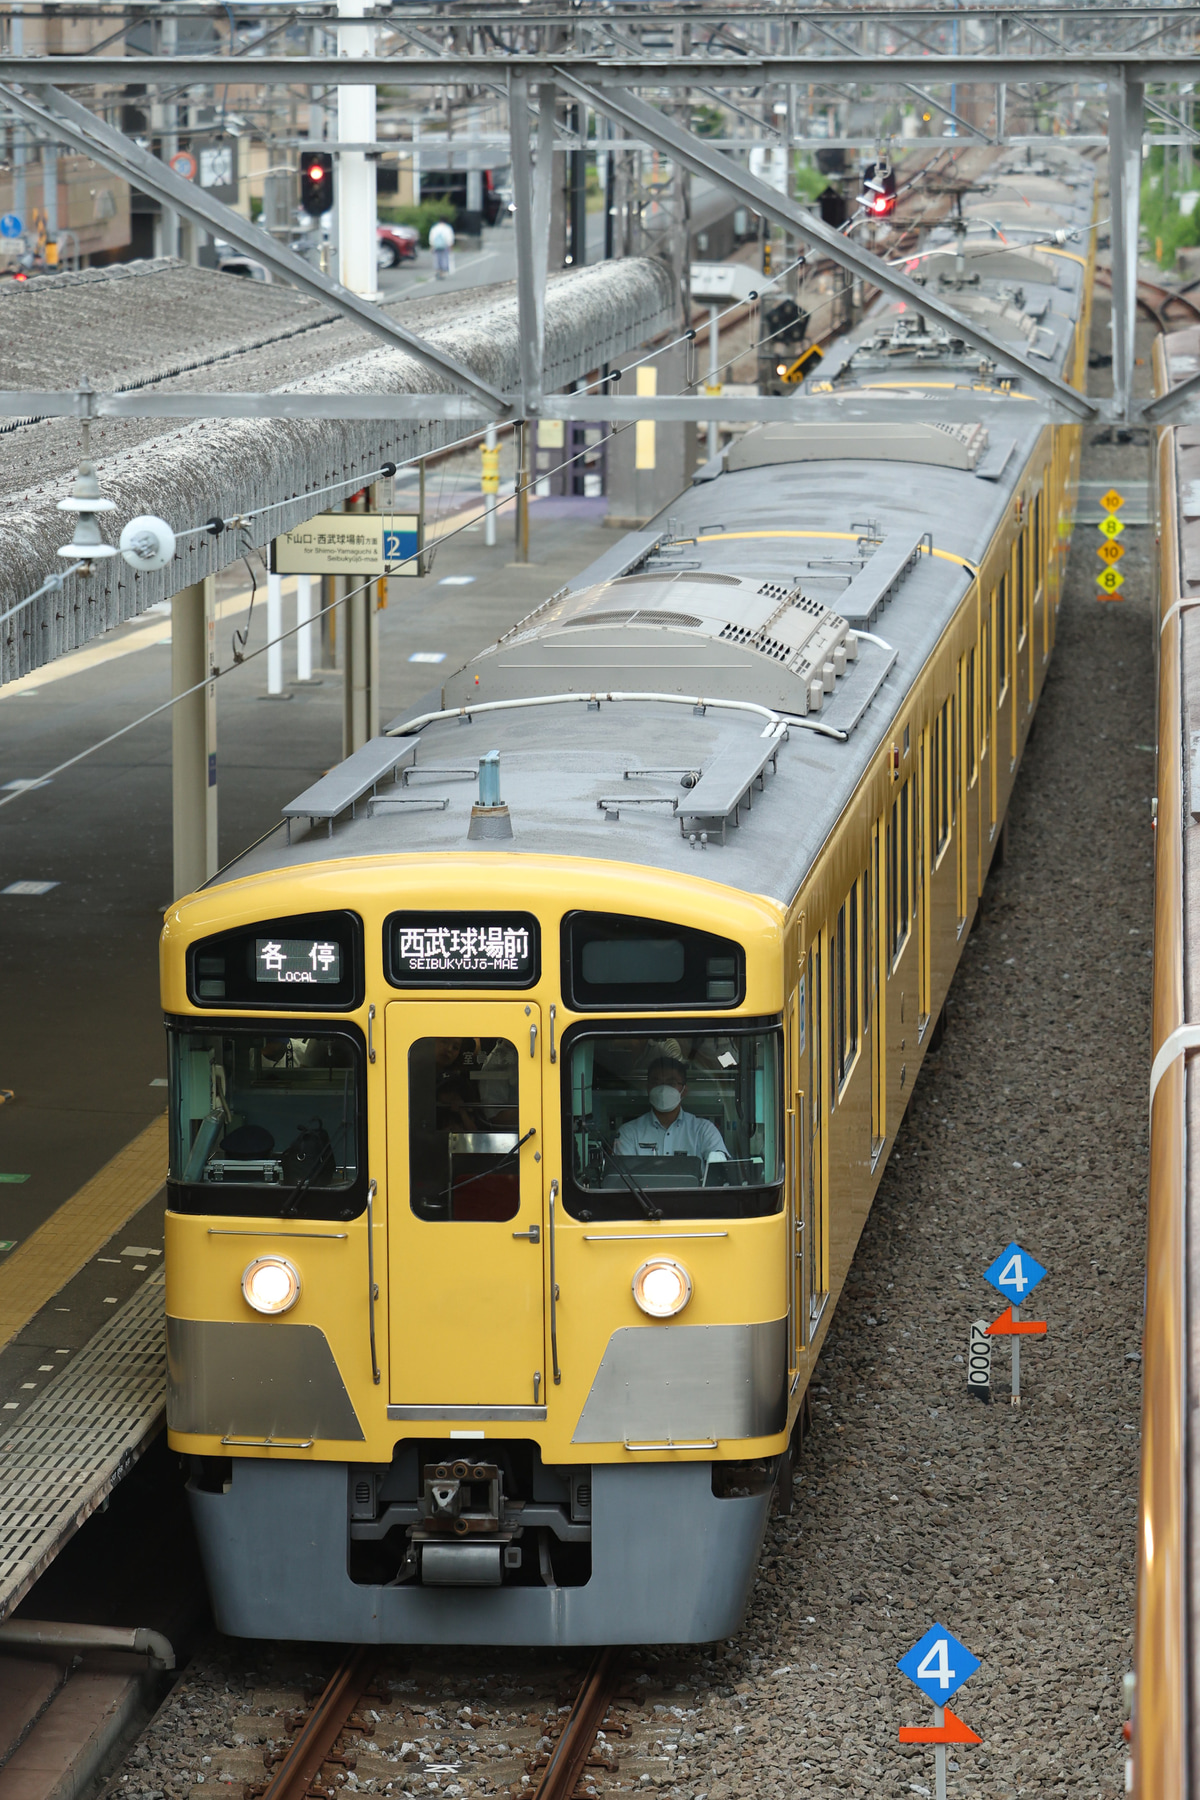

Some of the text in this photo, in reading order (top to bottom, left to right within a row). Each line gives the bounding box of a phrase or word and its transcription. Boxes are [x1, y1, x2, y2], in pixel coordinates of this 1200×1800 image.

[1106, 496, 1120, 508] 10
[1106, 520, 1117, 534] 8
[386, 536, 401, 557] 2
[1104, 546, 1119, 559] 10
[1105, 573, 1116, 588] 8
[399, 926, 529, 959] 西武球場前
[277, 971, 318, 983] LOCAL
[998, 1254, 1029, 1293] 4
[969, 1325, 991, 1384] 2000
[917, 1639, 956, 1689] 4
